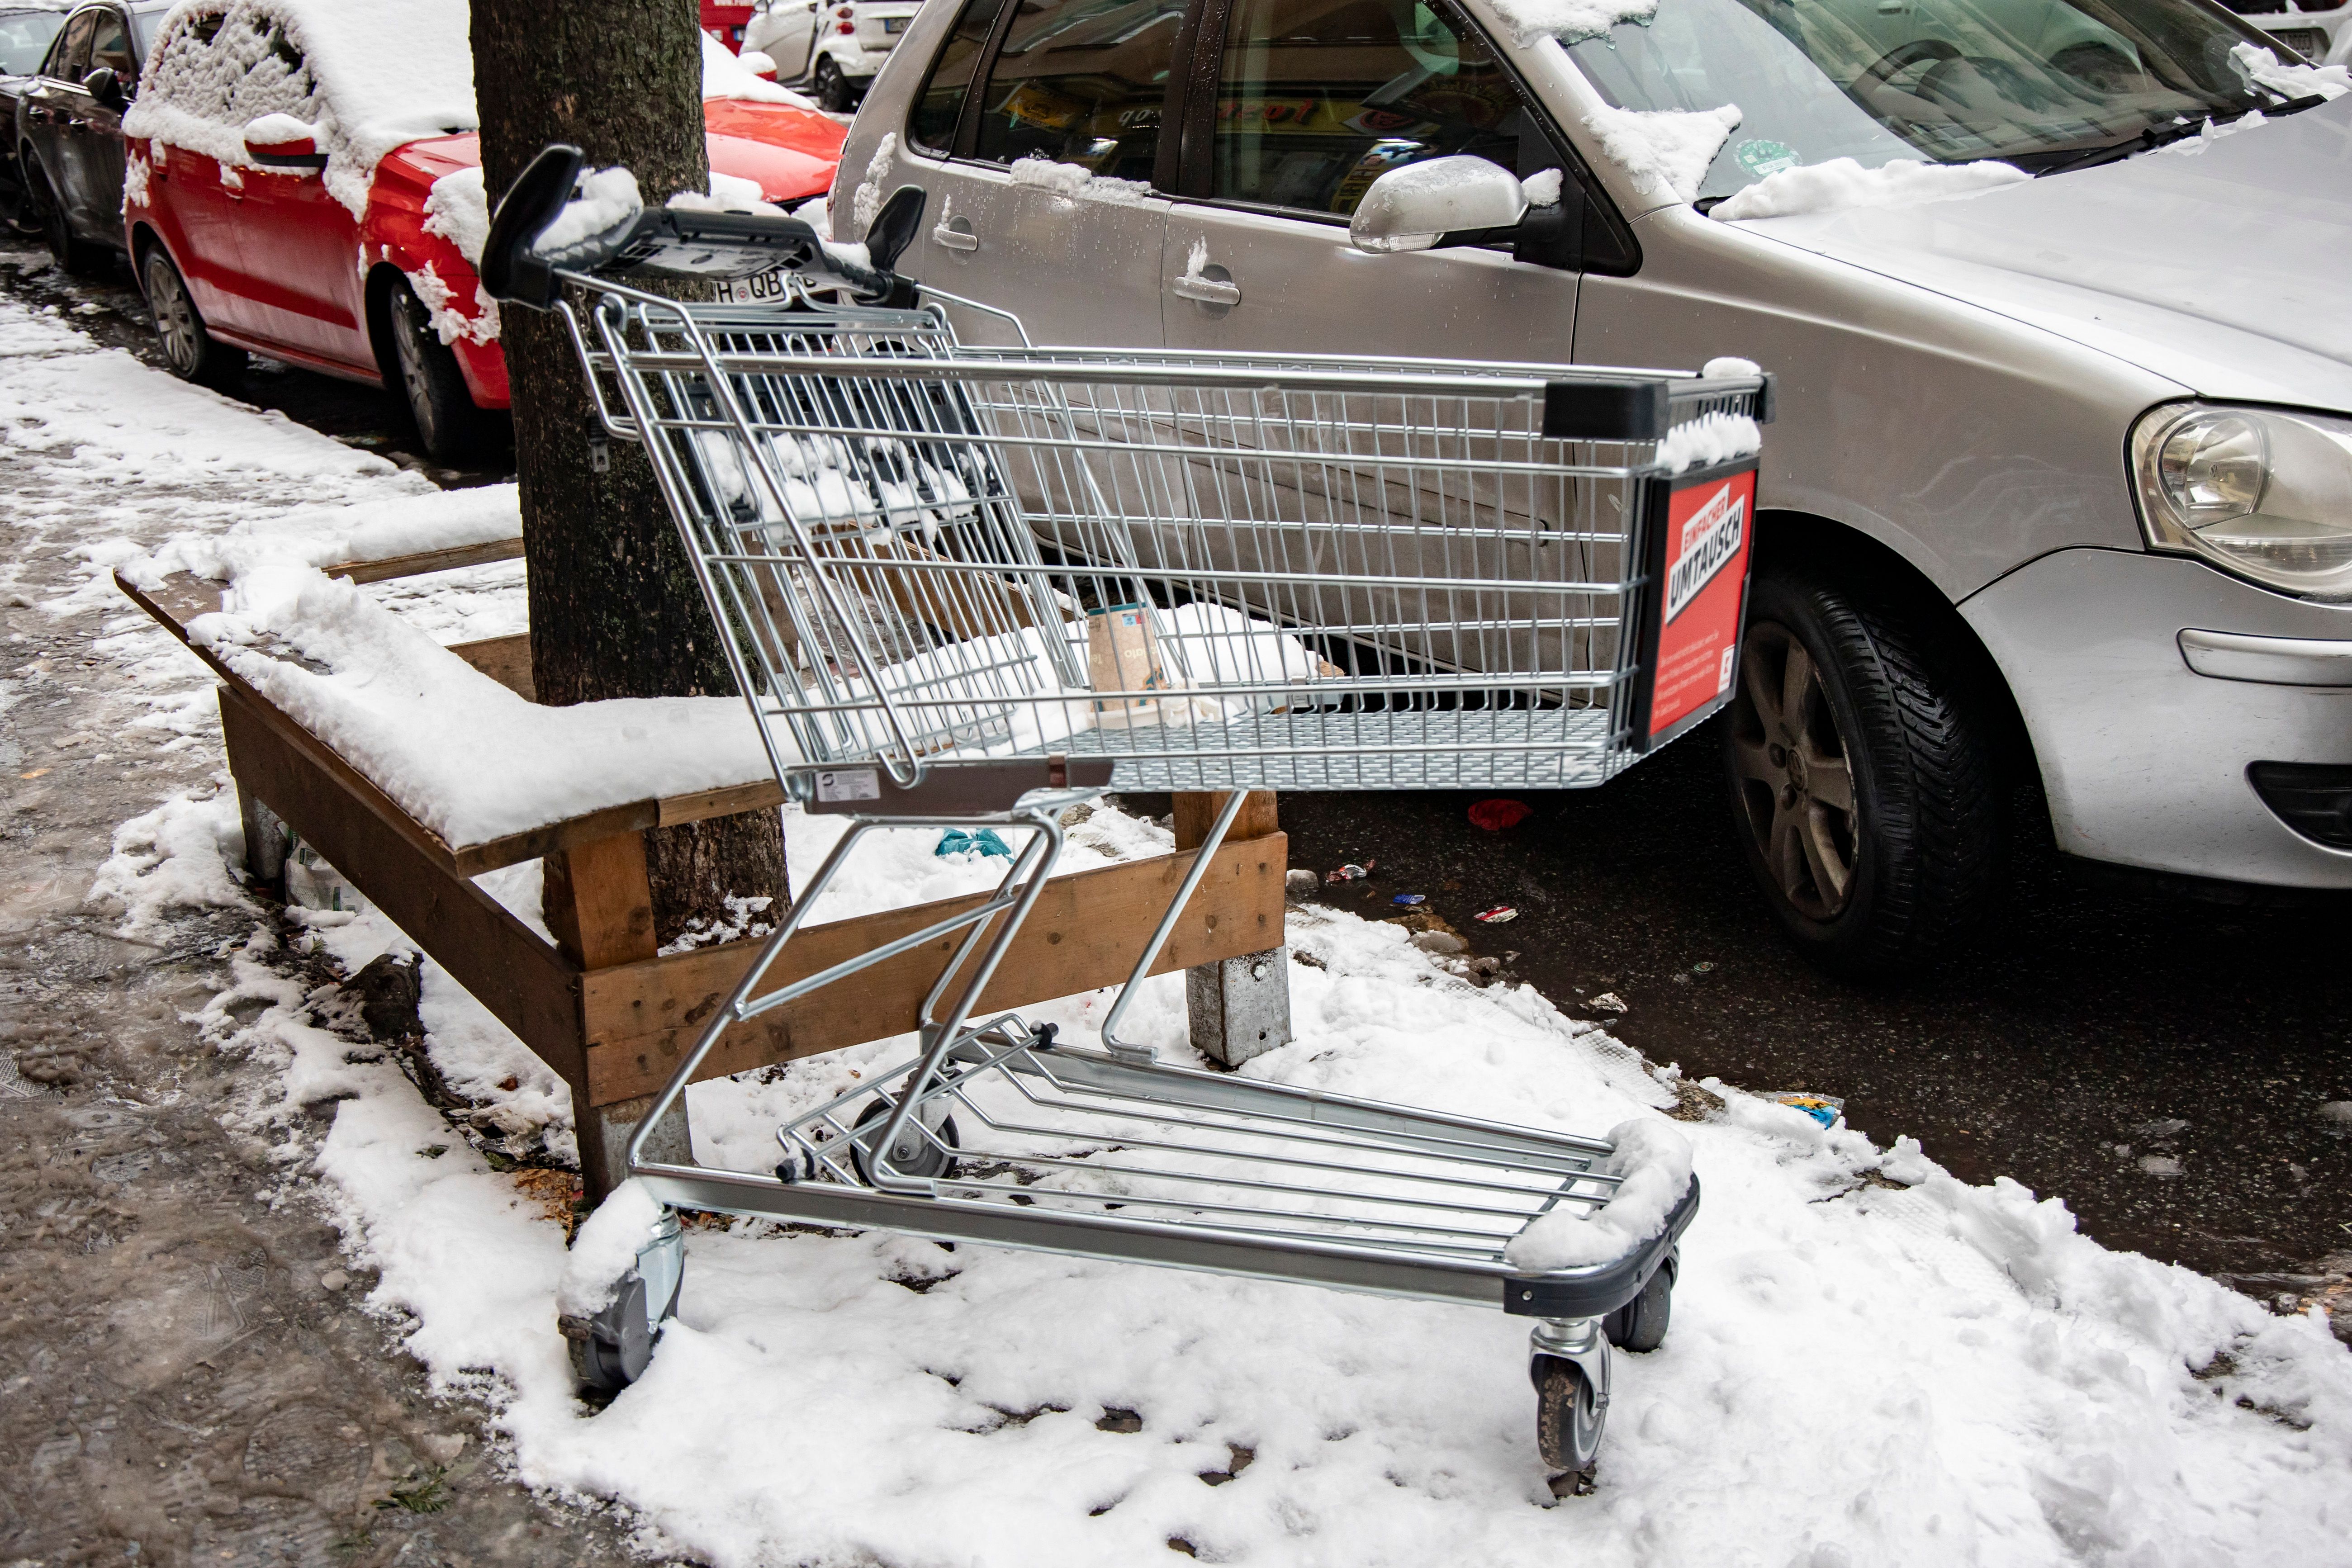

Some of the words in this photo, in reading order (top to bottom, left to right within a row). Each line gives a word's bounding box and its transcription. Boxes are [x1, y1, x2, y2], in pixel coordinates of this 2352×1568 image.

[716, 282, 734, 303] H
[1684, 496, 1727, 553] EINFACHER
[1671, 506, 1741, 609] UMTAUSCH
